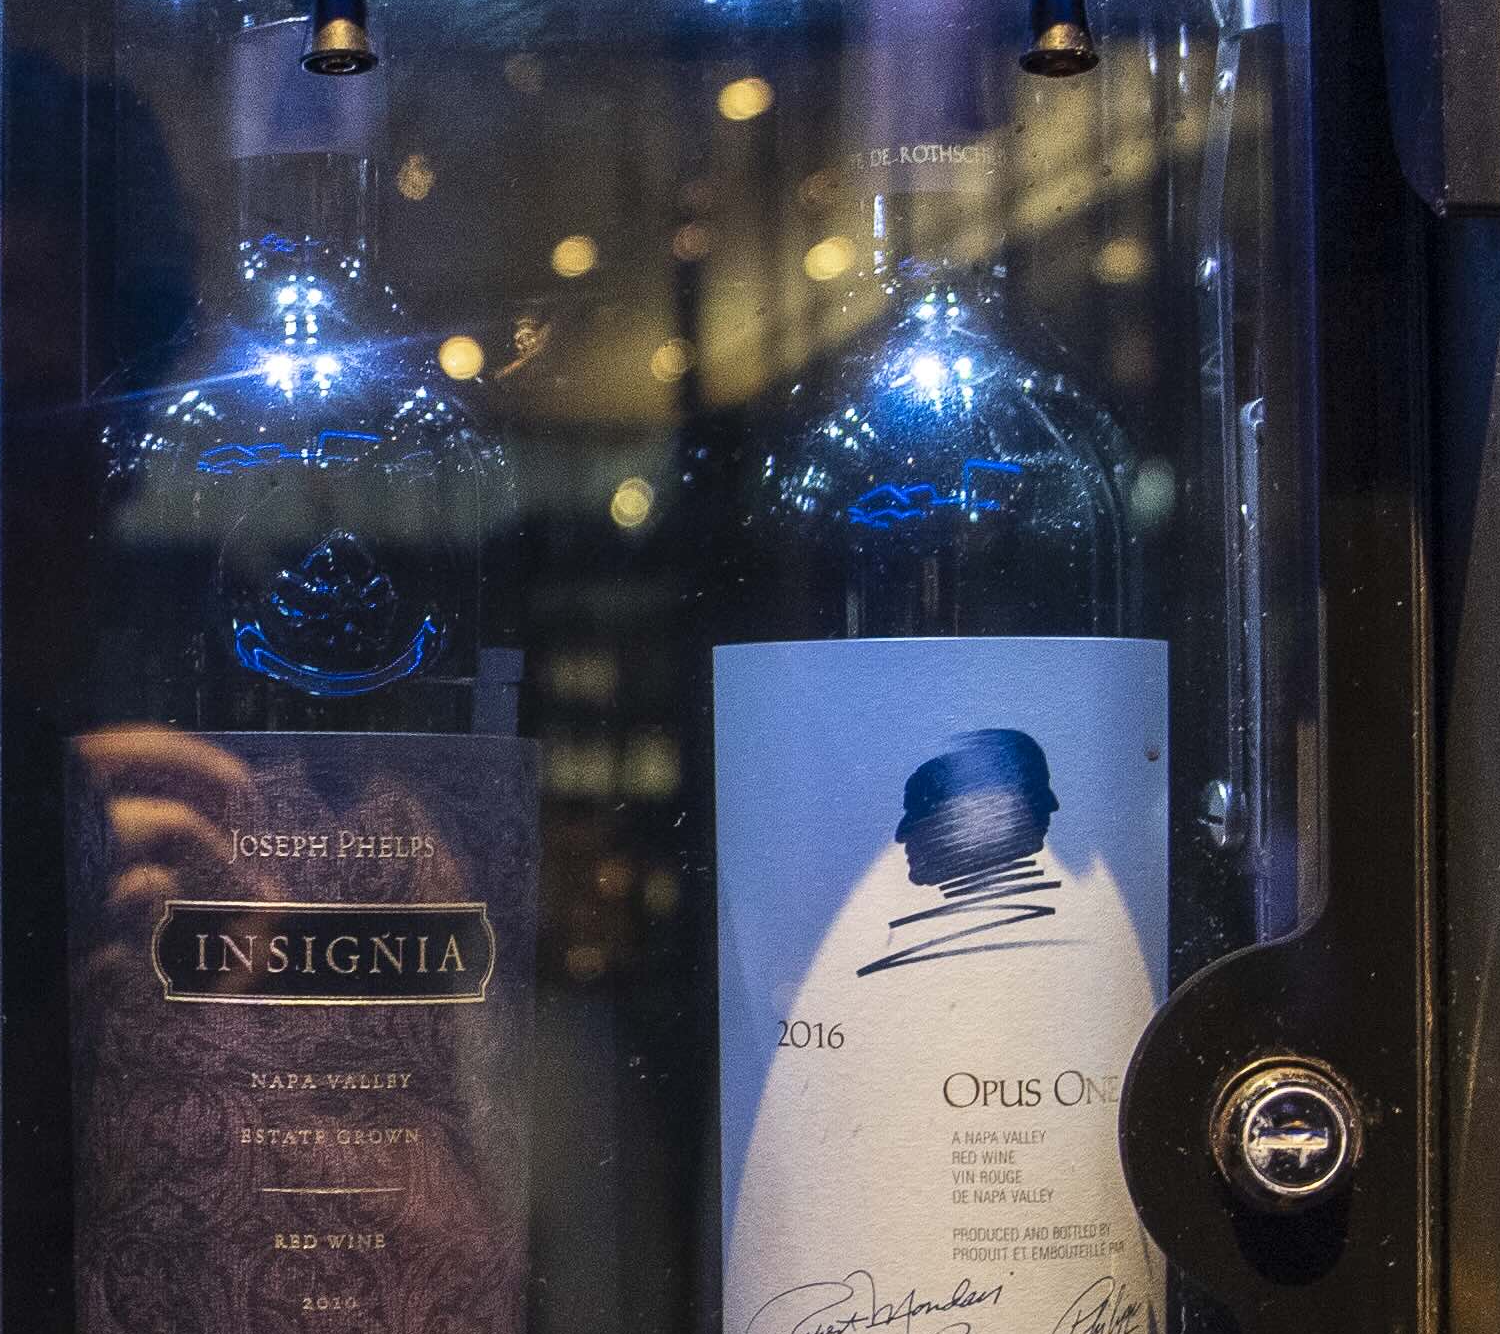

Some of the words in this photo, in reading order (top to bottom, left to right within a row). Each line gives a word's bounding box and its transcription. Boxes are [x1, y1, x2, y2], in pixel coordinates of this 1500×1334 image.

[870, 147, 891, 168] DE
[228, 828, 329, 865] JOSEPH
[336, 828, 437, 860] PHELPS
[194, 932, 468, 976] INSIGNIA
[777, 1019, 845, 1050] 2016
[250, 1072, 317, 1089] NAPA
[326, 1072, 413, 1090] VALLEY
[942, 1071, 1042, 1109] OPUS
[1053, 1069, 1120, 1107] ONE
[240, 1128, 326, 1146] ESTATE
[336, 1128, 420, 1146] GROWN
[951, 1130, 961, 1145] A
[964, 1130, 1000, 1145] NAPA
[1002, 1130, 1047, 1145] VALLEY
[951, 1150, 977, 1165] RED
[981, 1149, 1016, 1164] WINE
[951, 1169, 975, 1185] VIN
[979, 1169, 1024, 1184] ROUGE
[952, 1189, 969, 1204] DE
[973, 1189, 1007, 1204] NAPA
[1010, 1188, 1055, 1204] VALLEY
[274, 1233, 318, 1250] RED
[326, 1233, 386, 1250] WINE
[952, 1227, 1019, 1242] PRODUCED
[1022, 1226, 1049, 1241] AND
[1052, 1224, 1097, 1240] BOTTLED
[952, 1246, 1009, 1261] PRODUIT
[1012, 1246, 1028, 1261] ET
